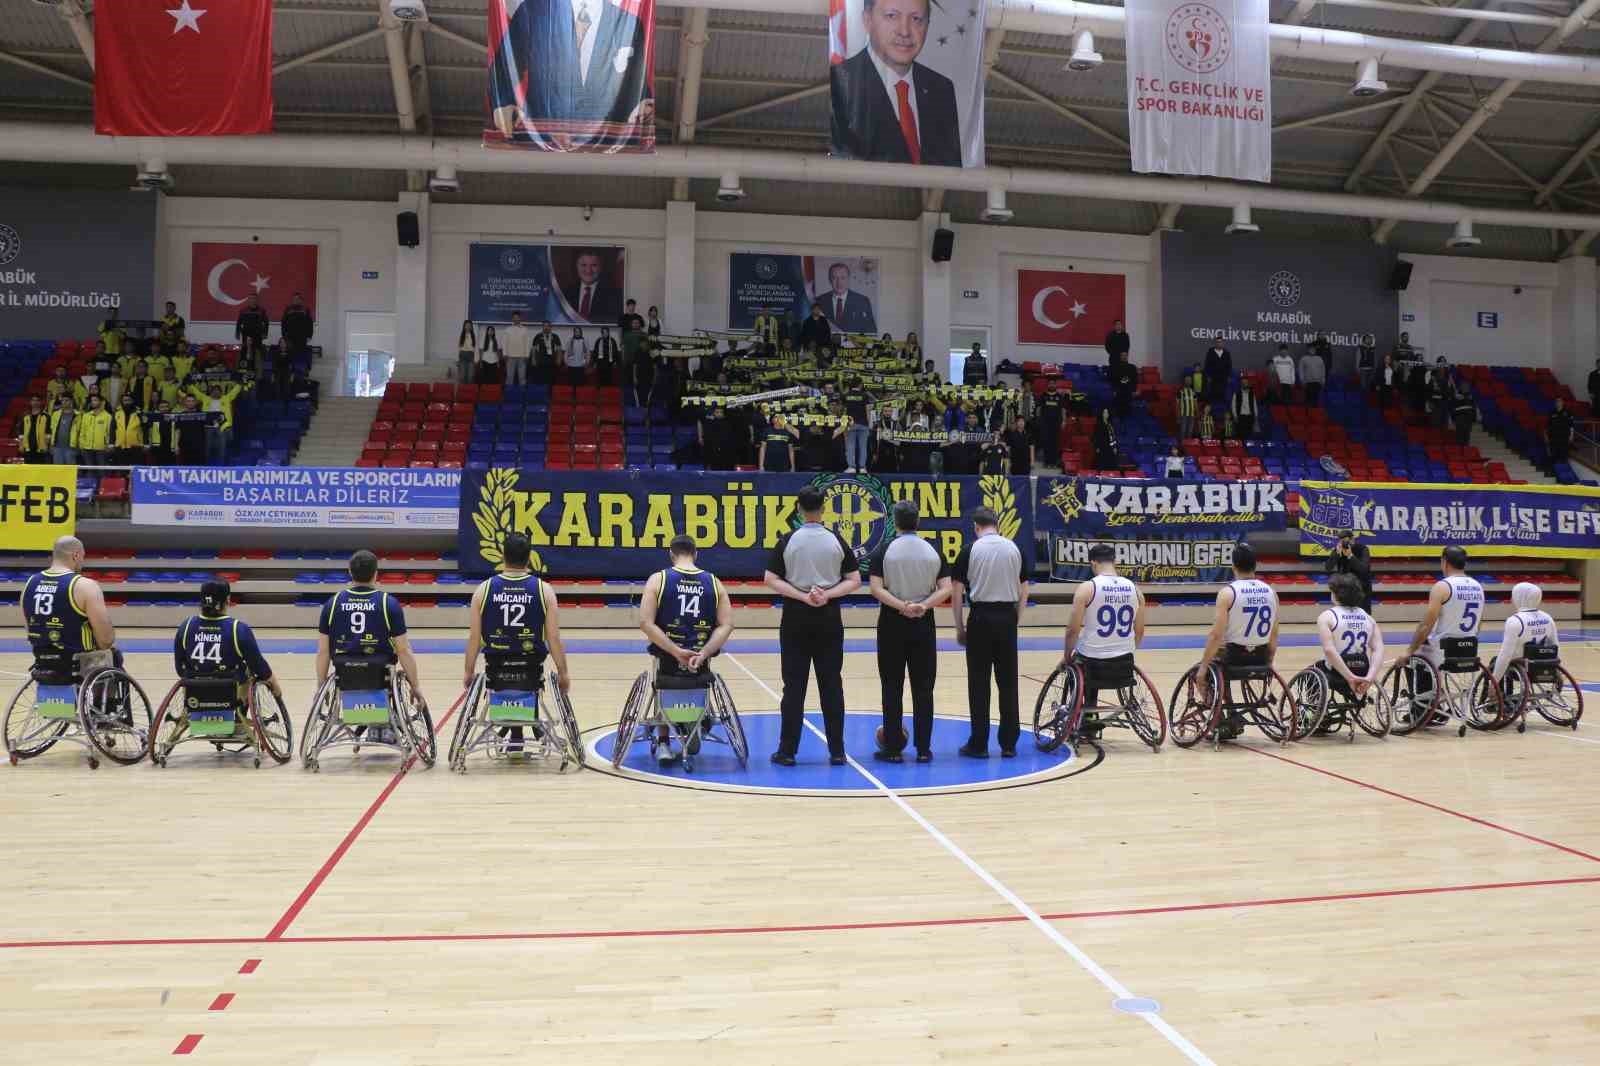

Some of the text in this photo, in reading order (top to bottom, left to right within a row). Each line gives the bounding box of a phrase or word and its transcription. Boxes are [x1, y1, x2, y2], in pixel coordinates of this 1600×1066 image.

[1136, 77, 1263, 102] T.C. GENÇLİK VE
[1137, 97, 1264, 121] SPOR BAKANLIĞI
[8, 290, 22, 306] İL
[24, 291, 121, 308] MÜDÜRLÜĞÜ
[1257, 311, 1312, 325] KARABÜK
[1242, 331, 1257, 342] VE
[1259, 331, 1289, 343] SPOR
[1291, 329, 1301, 344] İL
[138, 466, 174, 483] TÜM
[178, 469, 313, 485] TAKIMLARIMIZA
[317, 471, 340, 485] VE
[224, 486, 409, 504] BAŞARILAR DİLERİZ
[513, 482, 798, 549] KARABÜK
[1352, 501, 1485, 531] KARABÜK
[1492, 502, 1551, 533] LİSE
[1058, 540, 1190, 566] KAAMONU
[493, 592, 534, 604] MÜCAHİT
[676, 584, 704, 596] YAMAÇ
[33, 594, 54, 615] 13
[341, 603, 375, 612] TOPRAK
[500, 604, 526, 627] 12
[677, 595, 701, 618] 14
[350, 612, 366, 634] 9
[1097, 605, 1134, 638] 99
[1242, 606, 1272, 638] 78
[1459, 602, 1480, 632] 5
[194, 631, 222, 642] KİNEM
[1341, 630, 1368, 653] 23
[190, 642, 222, 664] 44
